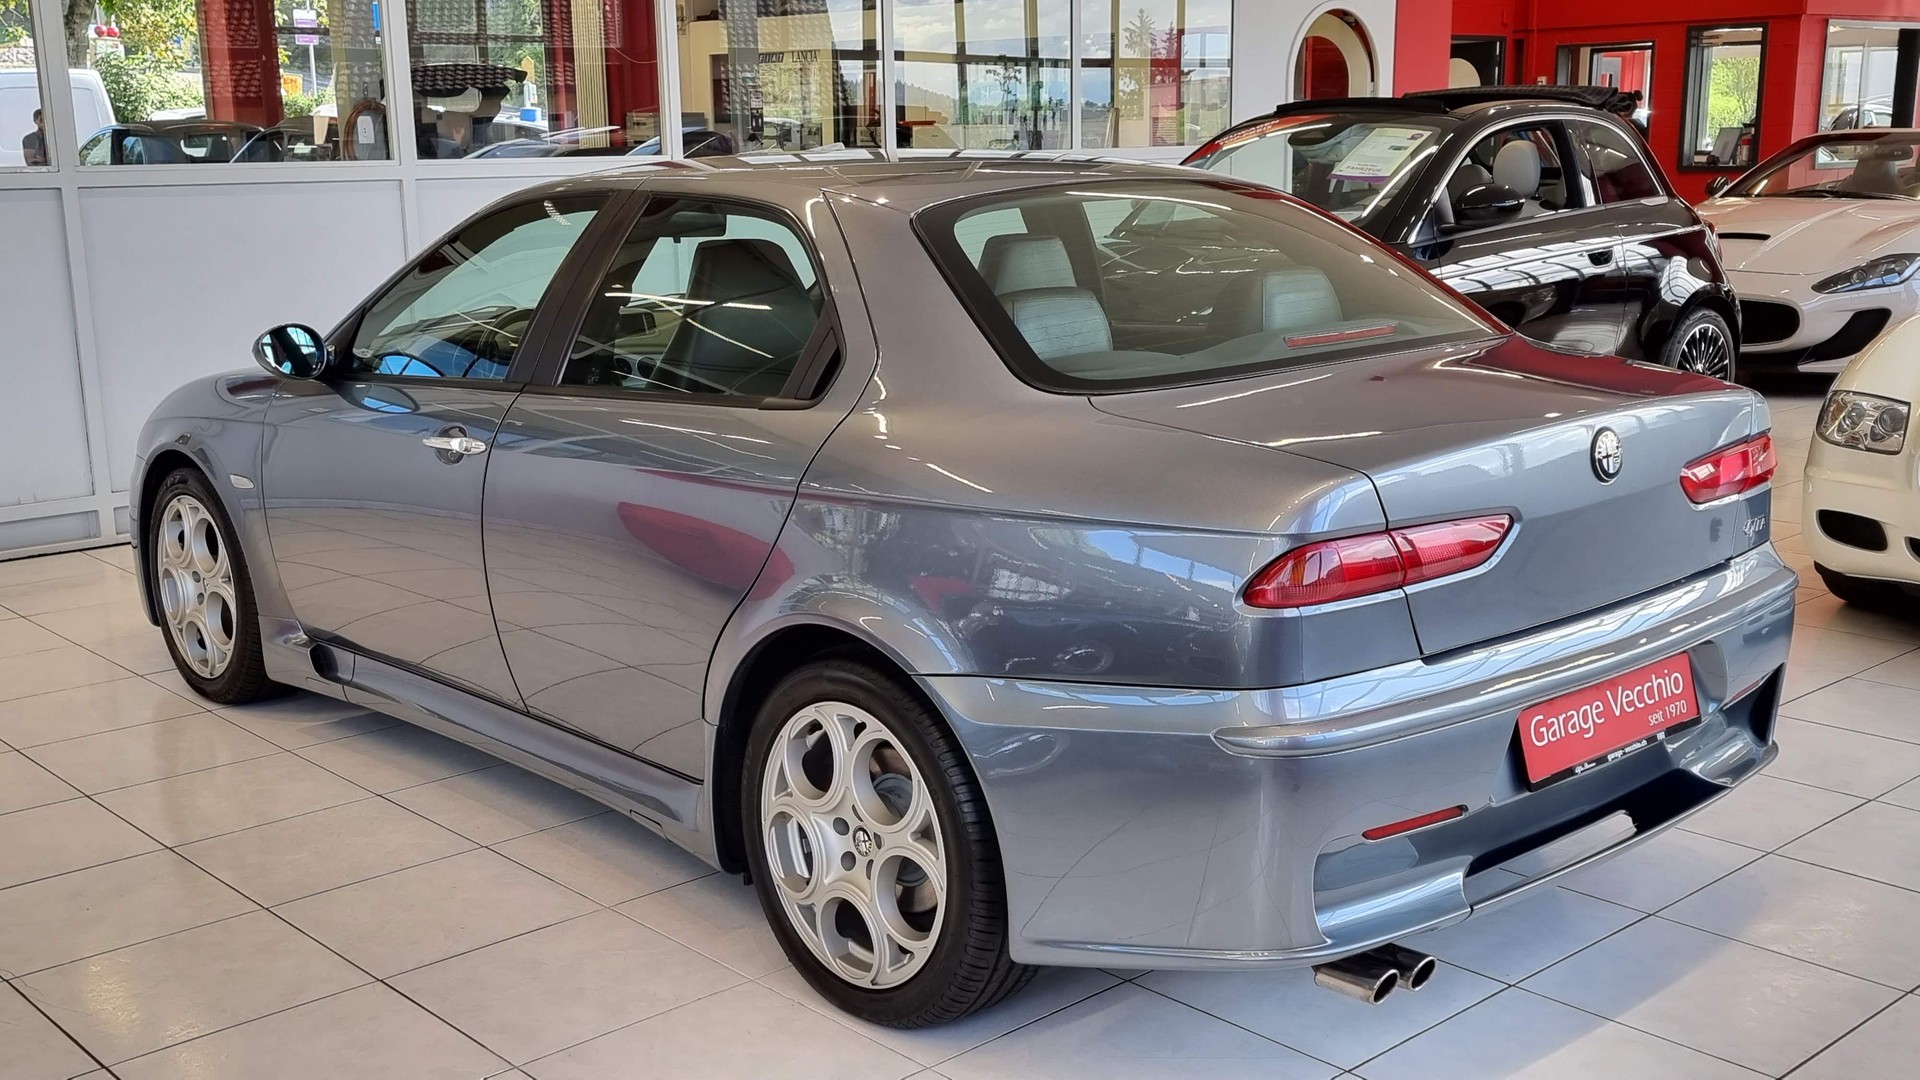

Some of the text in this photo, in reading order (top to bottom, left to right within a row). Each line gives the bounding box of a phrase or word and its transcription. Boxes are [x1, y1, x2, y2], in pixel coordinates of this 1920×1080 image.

[759, 50, 818, 63] FIAT LANCIA
[1529, 669, 1684, 748] Garage Vecchio
[1648, 699, 1687, 727] seit 1970
